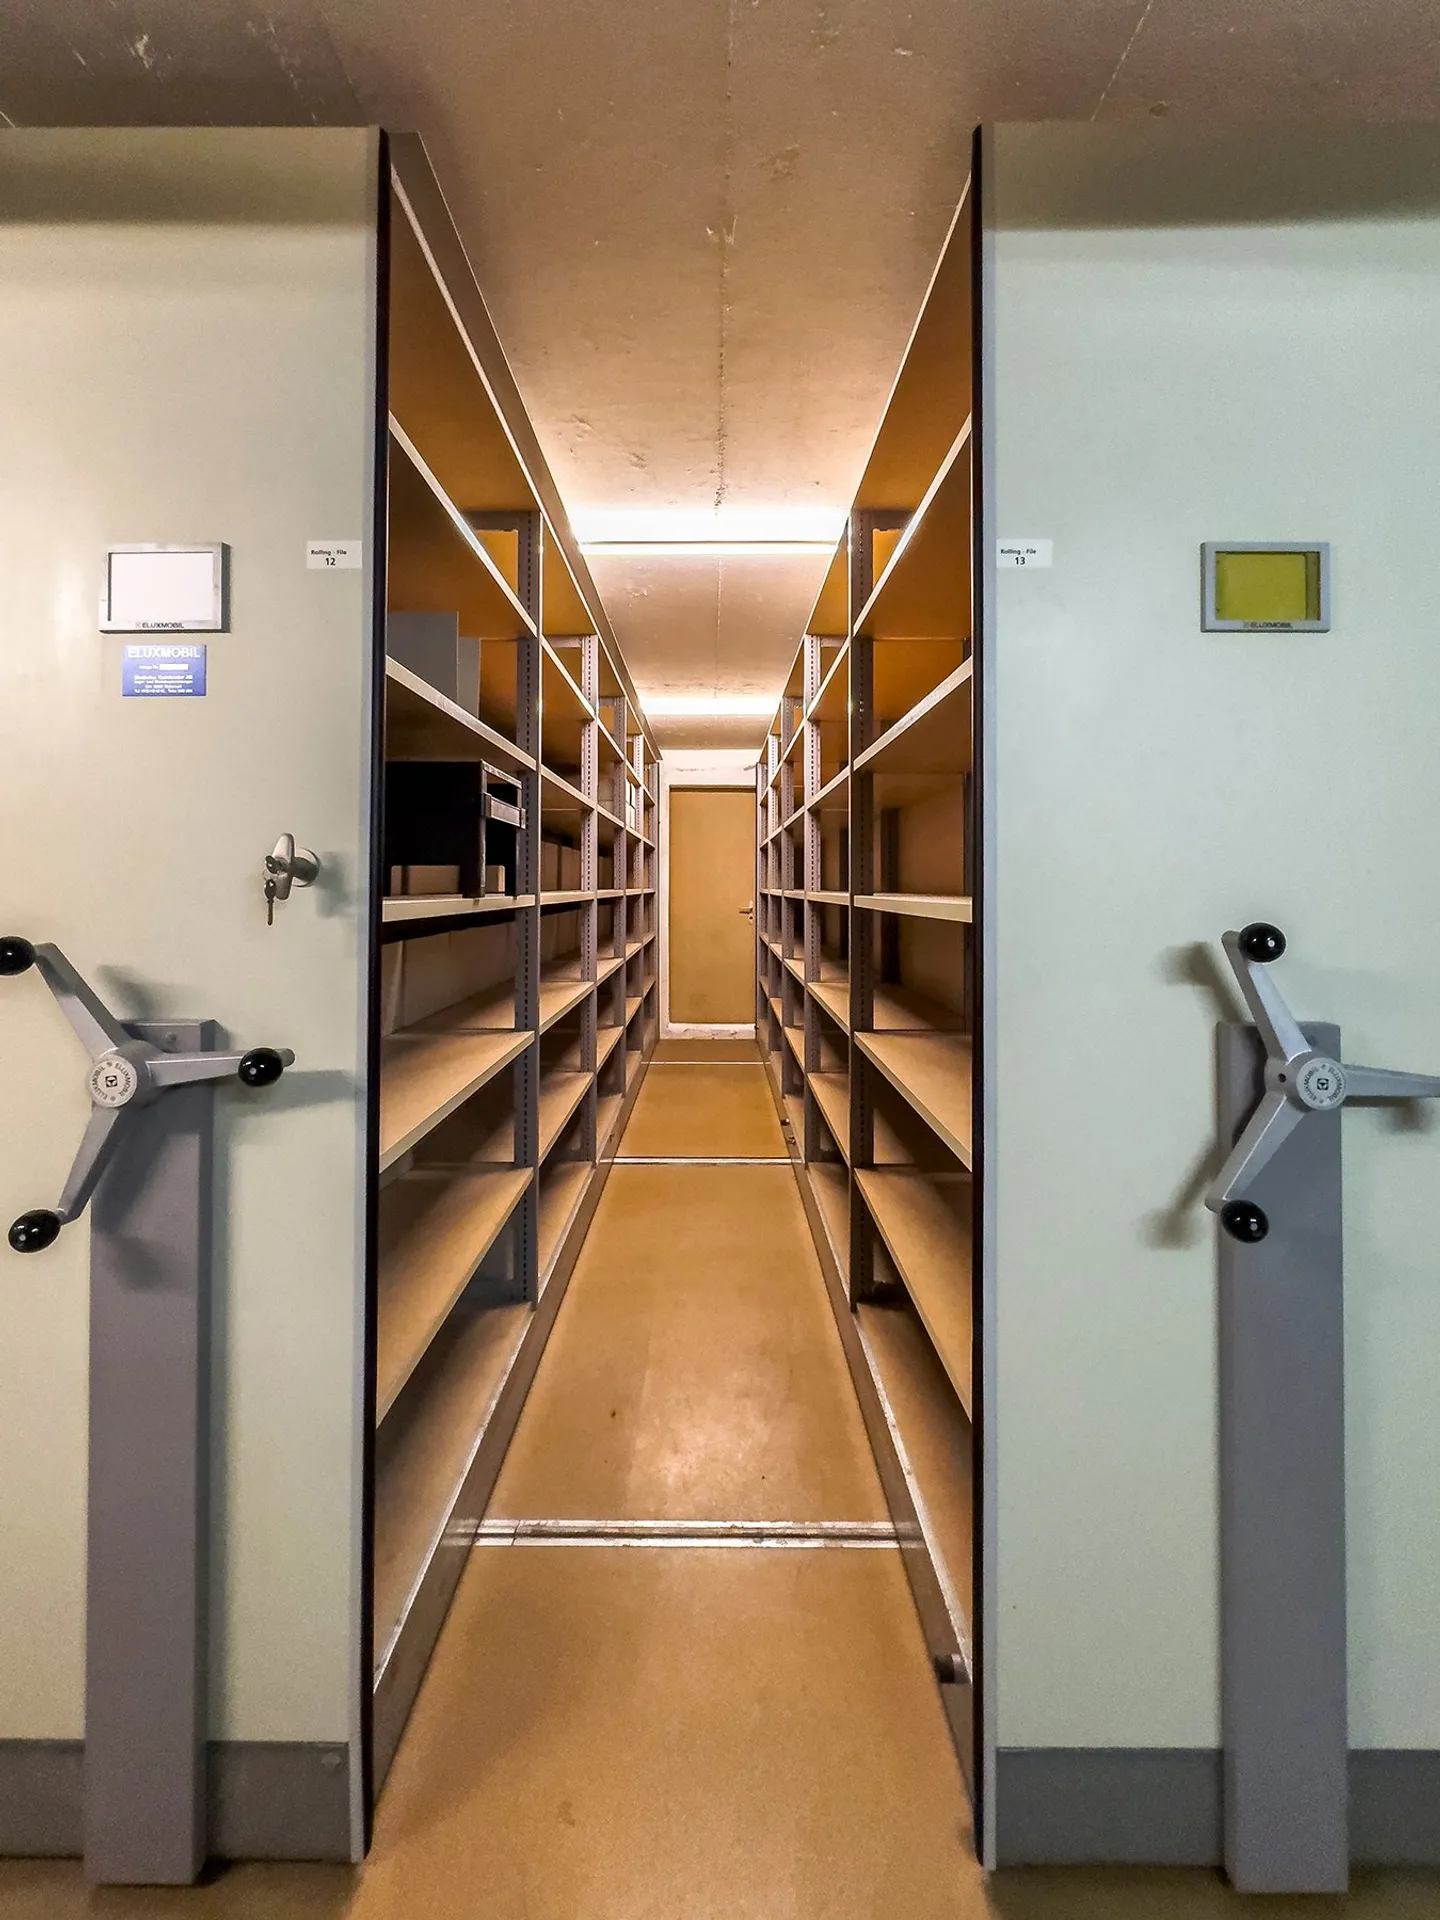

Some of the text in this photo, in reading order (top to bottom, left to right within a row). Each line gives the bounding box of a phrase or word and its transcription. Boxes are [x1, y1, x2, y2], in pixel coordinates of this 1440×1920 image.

[1000, 548, 1021, 556] Rolling
[325, 557, 336, 566] 12
[1014, 556, 1026, 565] 13
[127, 646, 201, 658] ELUXMOBIL
[91, 1066, 108, 1100] ELUXMOBIL
